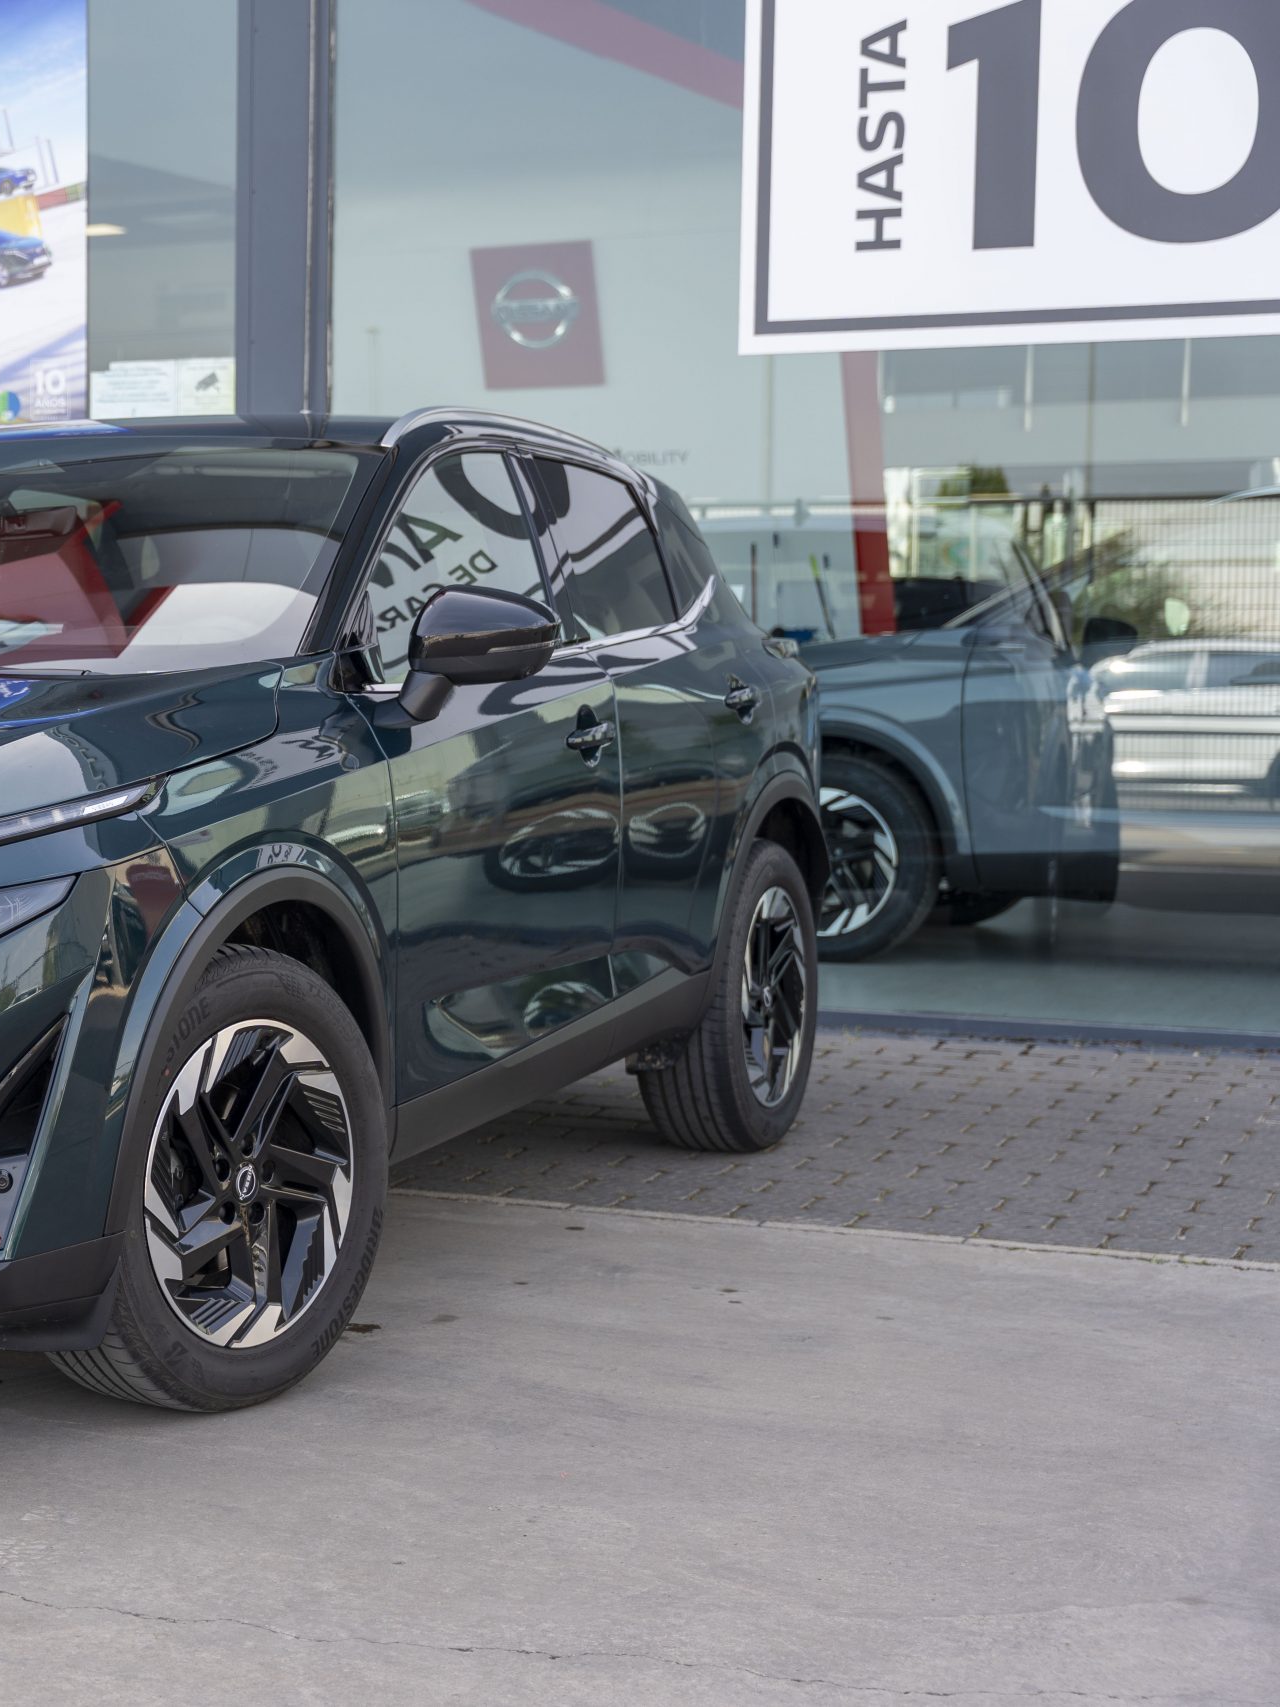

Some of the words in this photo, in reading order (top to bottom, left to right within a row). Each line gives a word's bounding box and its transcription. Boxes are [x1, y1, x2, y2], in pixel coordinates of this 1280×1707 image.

[855, 18, 908, 252] HASTA
[946, 0, 1280, 250] 10
[35, 369, 66, 396] 10
